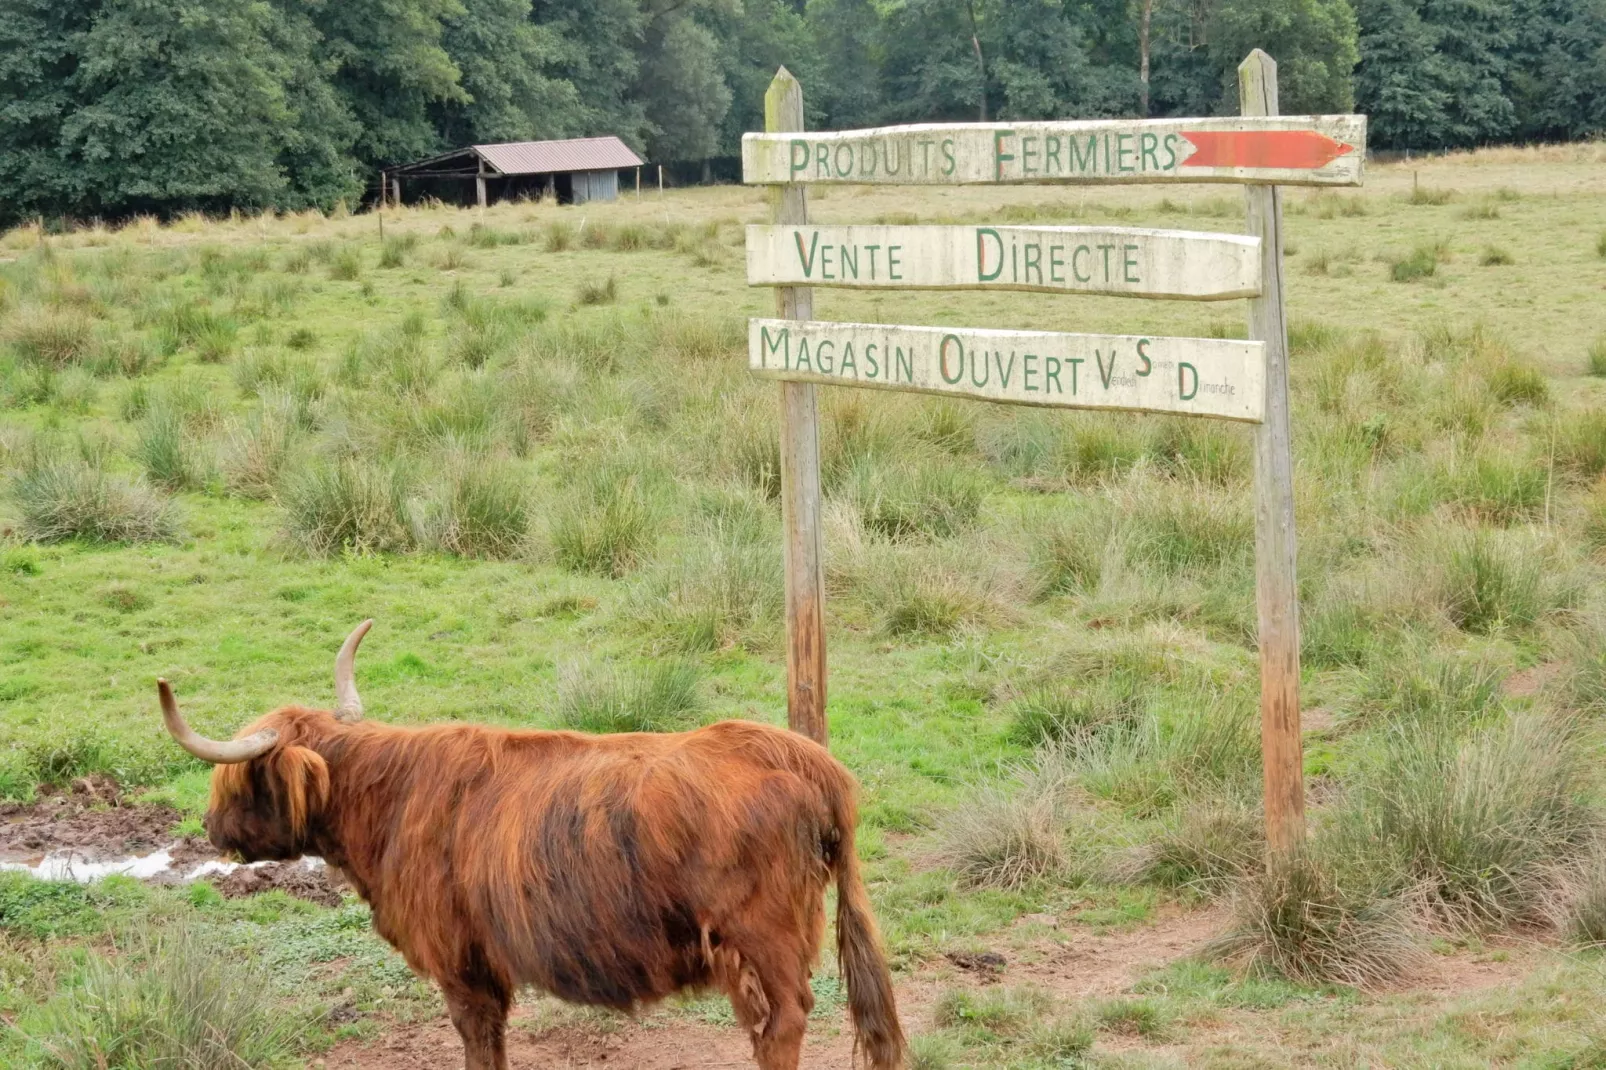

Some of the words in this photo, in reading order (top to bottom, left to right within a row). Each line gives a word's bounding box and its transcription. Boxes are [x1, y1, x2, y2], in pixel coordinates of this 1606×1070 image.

[790, 138, 956, 182] PRODUITS
[993, 129, 1178, 182] FERMIERS
[794, 230, 903, 280] VENTE
[939, 333, 1084, 396] OUVERT
